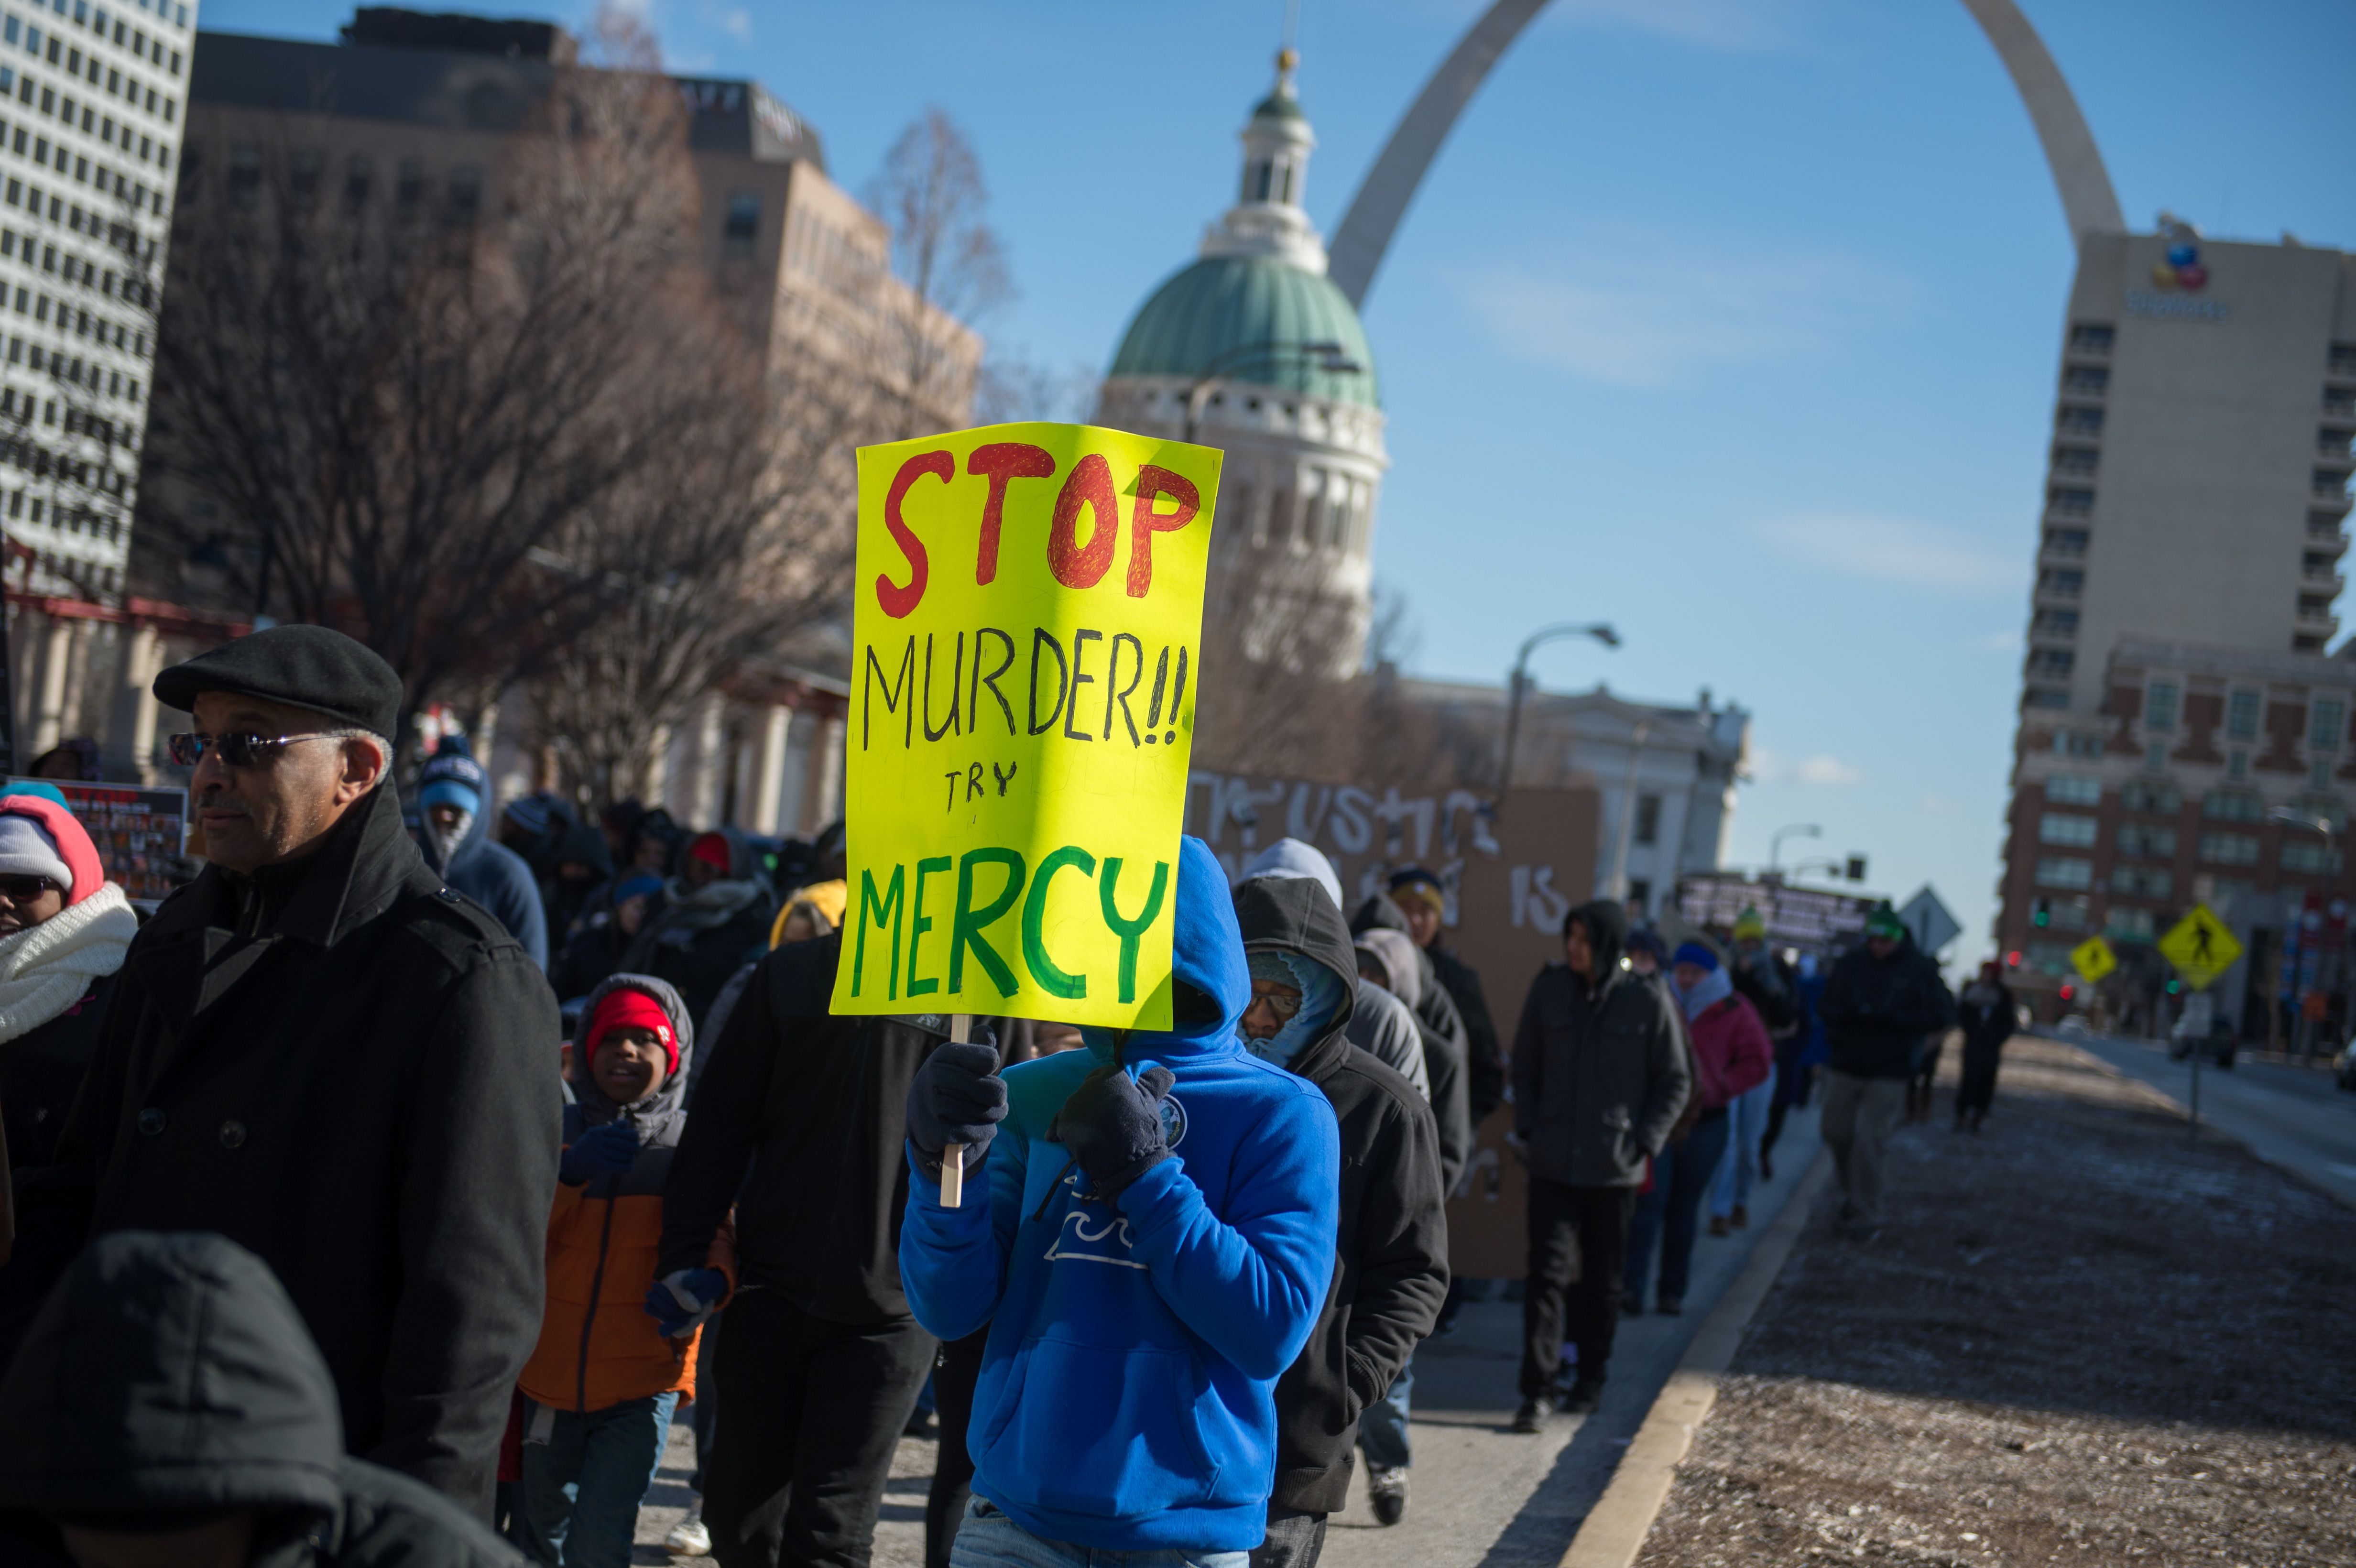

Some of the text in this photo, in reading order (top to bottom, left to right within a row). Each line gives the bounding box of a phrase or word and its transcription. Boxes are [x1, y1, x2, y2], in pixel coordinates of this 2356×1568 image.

[875, 442, 1200, 619] STOP
[863, 627, 1188, 751] MURDER!!
[945, 761, 1017, 814] TRY
[851, 845, 1169, 1004] MERCY
